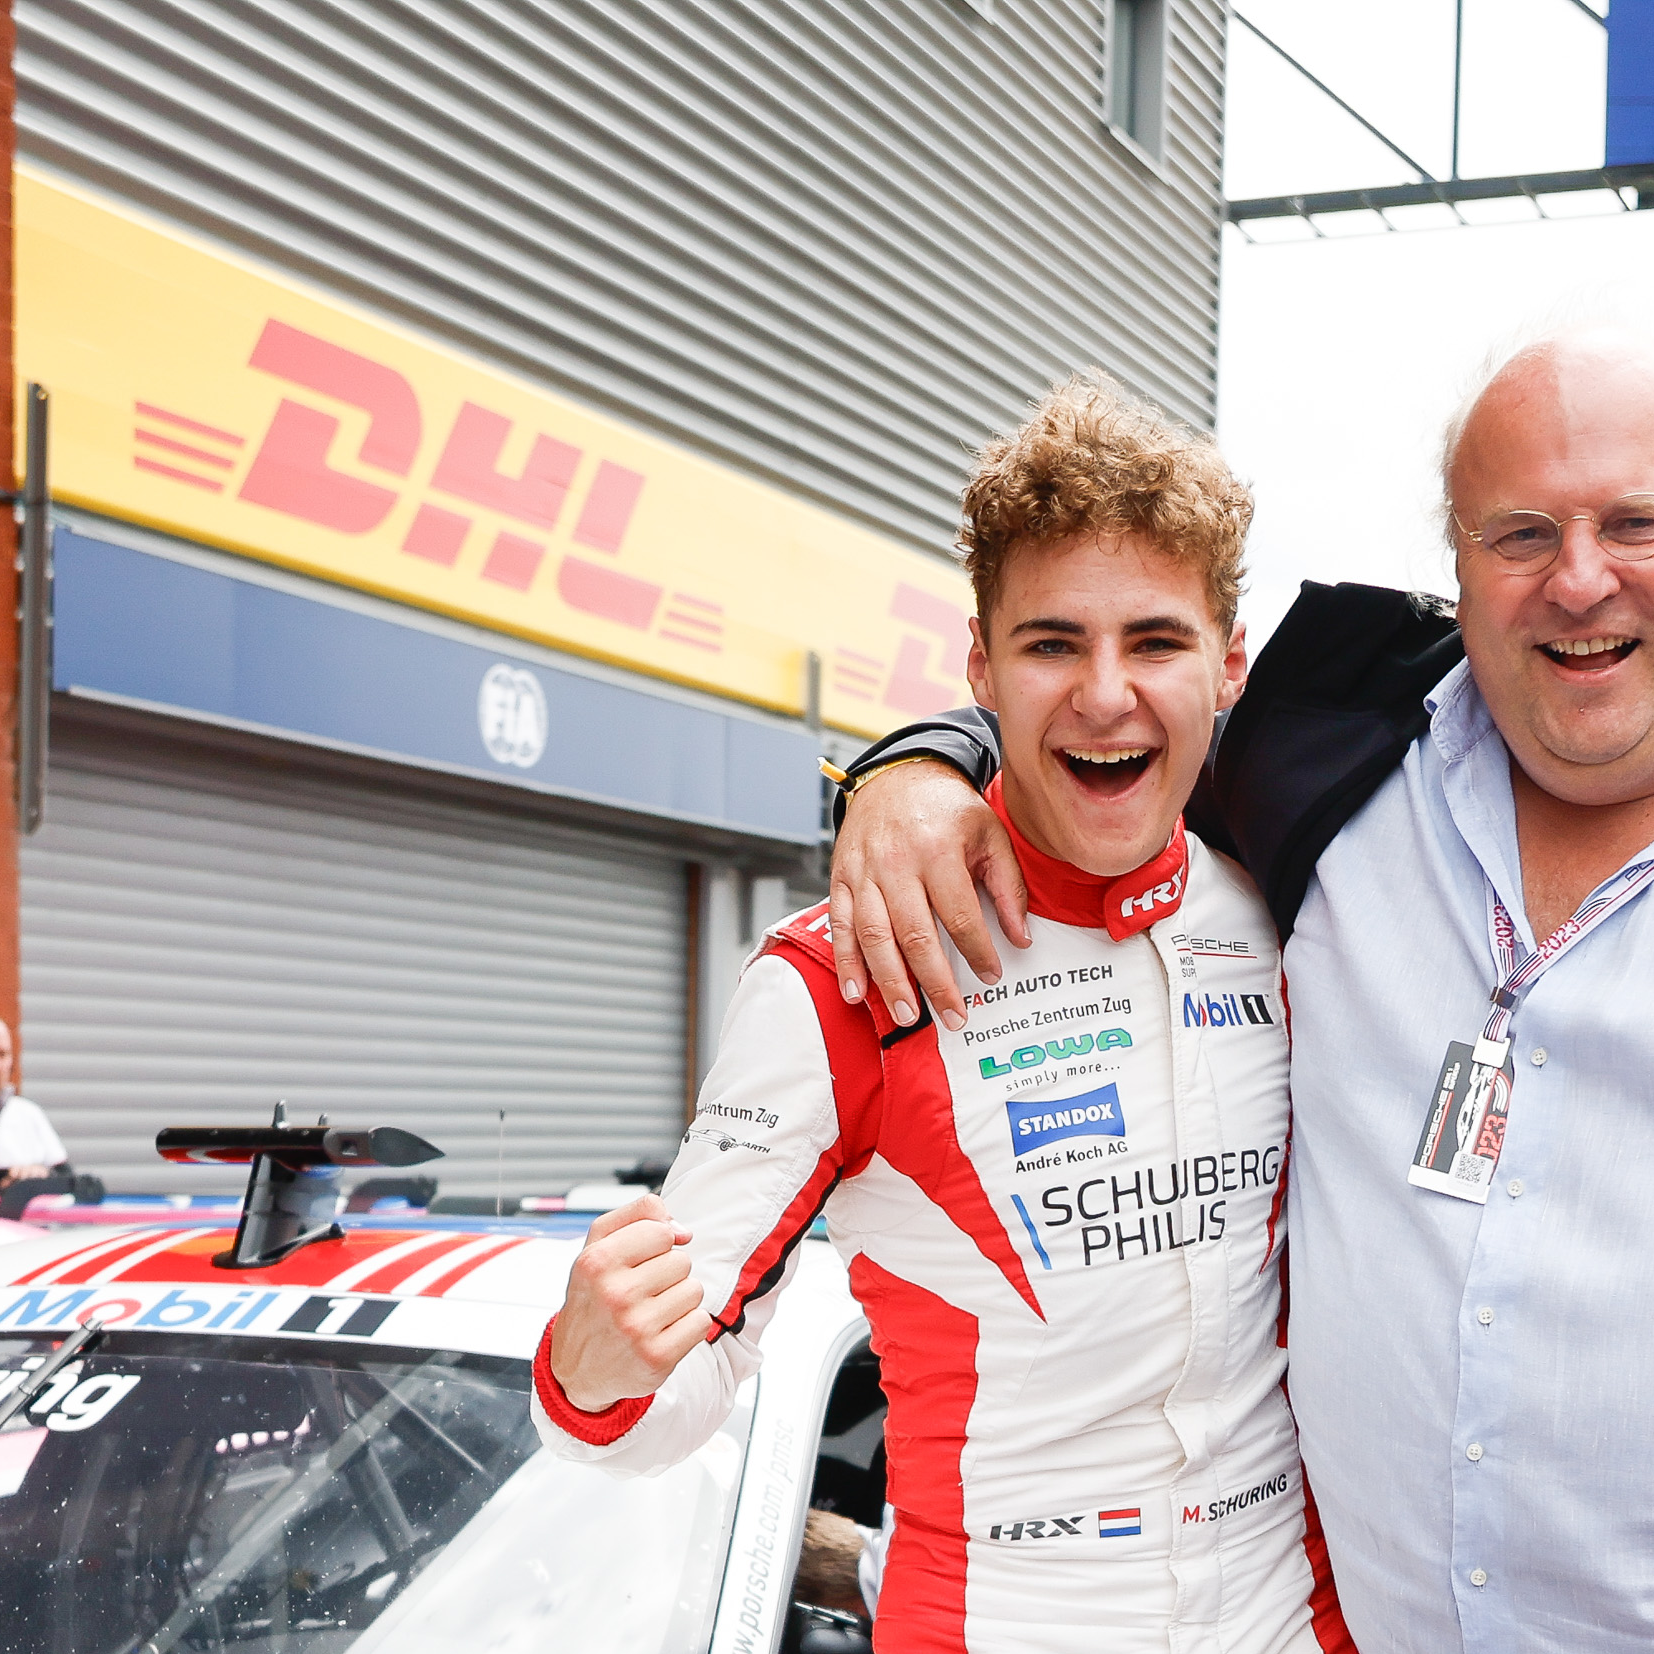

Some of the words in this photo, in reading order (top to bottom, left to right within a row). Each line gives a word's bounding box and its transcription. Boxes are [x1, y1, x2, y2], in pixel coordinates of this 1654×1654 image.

[236, 317, 666, 632] DHL
[1171, 934, 1250, 953] PSCHE
[1536, 918, 1581, 961] 2023
[962, 986, 1009, 1010] FACH
[1014, 973, 1062, 998] AUTO
[1067, 964, 1114, 985] TECH
[963, 1017, 1030, 1046] Porsche
[1031, 1002, 1100, 1027] Zentrum
[1102, 997, 1133, 1015] Zug
[978, 1027, 1134, 1080] LOWA
[1005, 1070, 1058, 1092] simply
[755, 1107, 780, 1129] Zug
[1018, 1102, 1115, 1136] STANDOX
[1015, 1153, 1062, 1174] André
[1067, 1145, 1100, 1163] Koch
[1107, 1141, 1128, 1154] AG
[1042, 1146, 1280, 1227] SCHUBERG
[1081, 1200, 1227, 1267] PHILIS
[989, 1516, 1087, 1541] HRX
